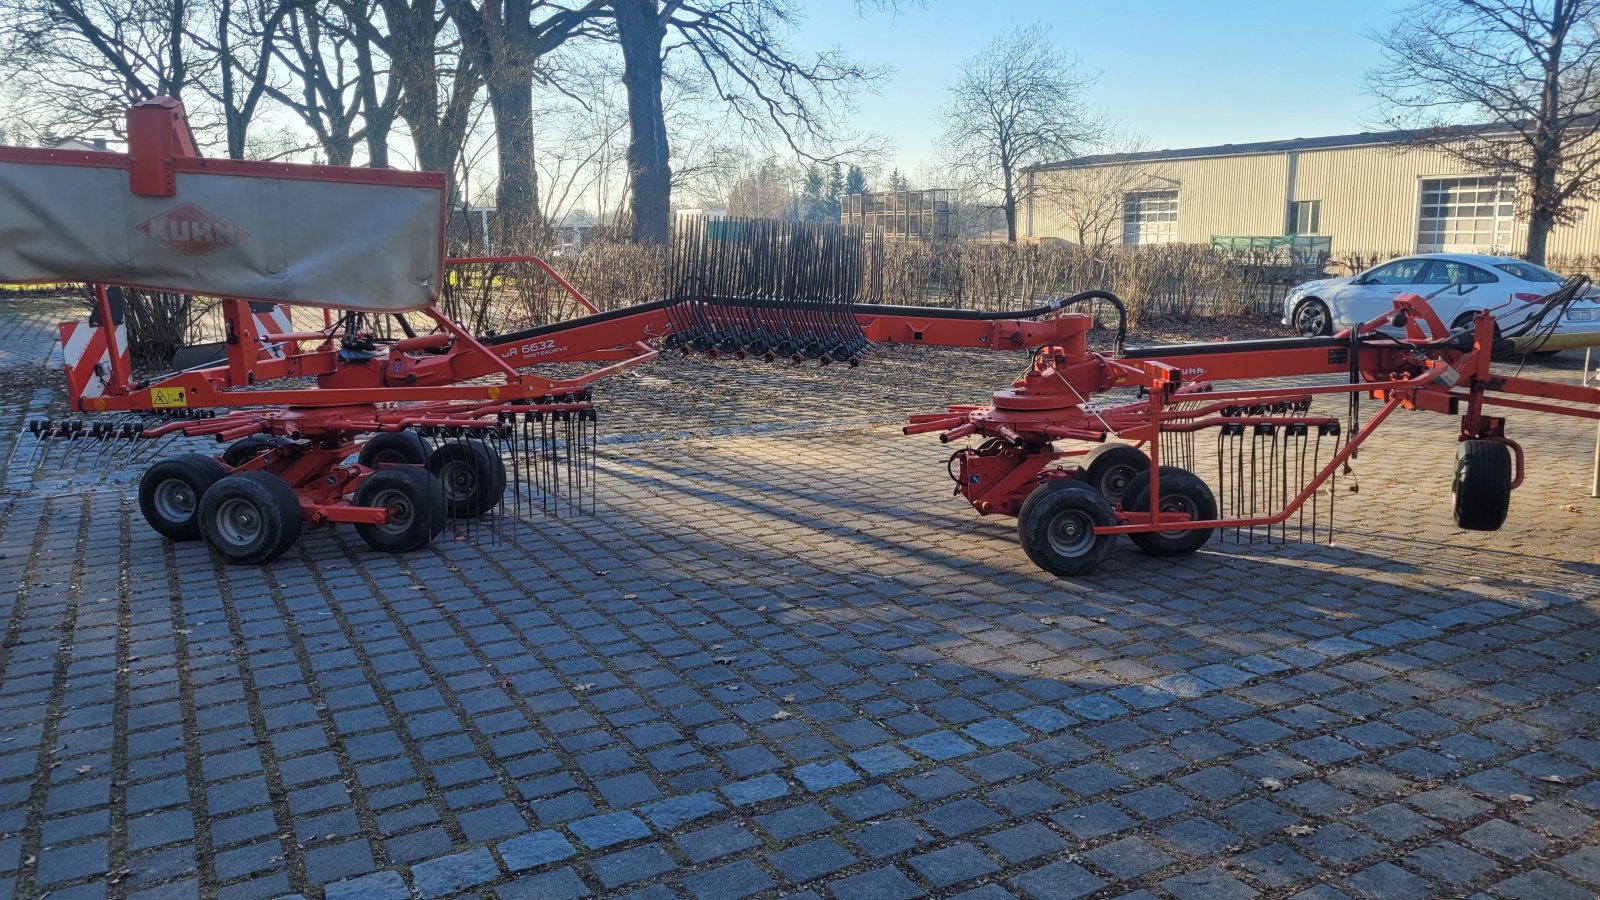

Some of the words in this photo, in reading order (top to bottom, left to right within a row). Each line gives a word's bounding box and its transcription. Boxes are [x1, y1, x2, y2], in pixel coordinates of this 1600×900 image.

[150, 219, 235, 242] KUHN
[521, 339, 556, 354] 6632
[523, 345, 569, 360] MASTERDRIVE
[1181, 367, 1205, 375] UHN
